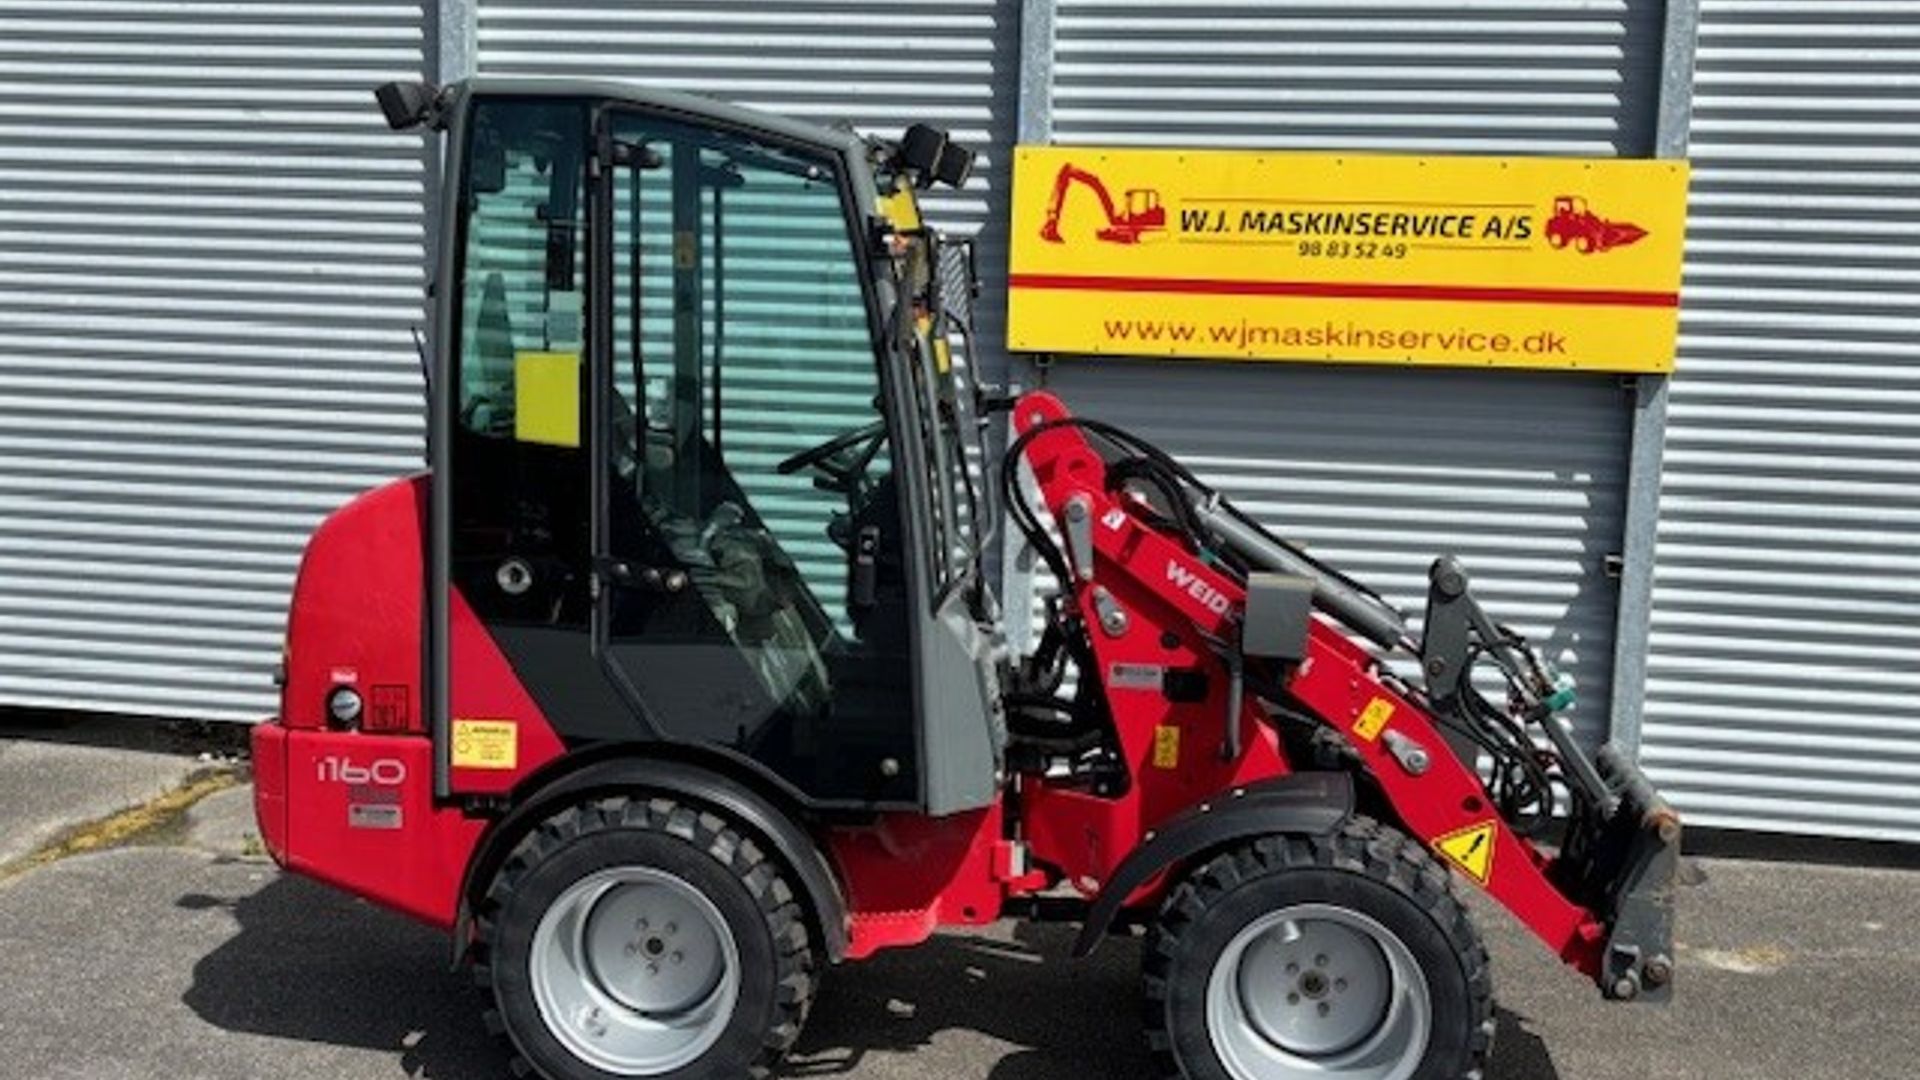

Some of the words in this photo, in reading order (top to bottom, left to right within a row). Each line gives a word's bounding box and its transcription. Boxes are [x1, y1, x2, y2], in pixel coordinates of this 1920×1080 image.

[1181, 209, 1231, 232] W.J.
[1238, 210, 1476, 238] MASKINSERVICE
[1481, 215, 1532, 239] A/S
[1299, 240, 1322, 257] 98
[1326, 241, 1350, 259] 83
[1354, 242, 1378, 259] 52
[1382, 243, 1407, 259] 49
[1103, 319, 1567, 355] www.wjmaskinservice.dk
